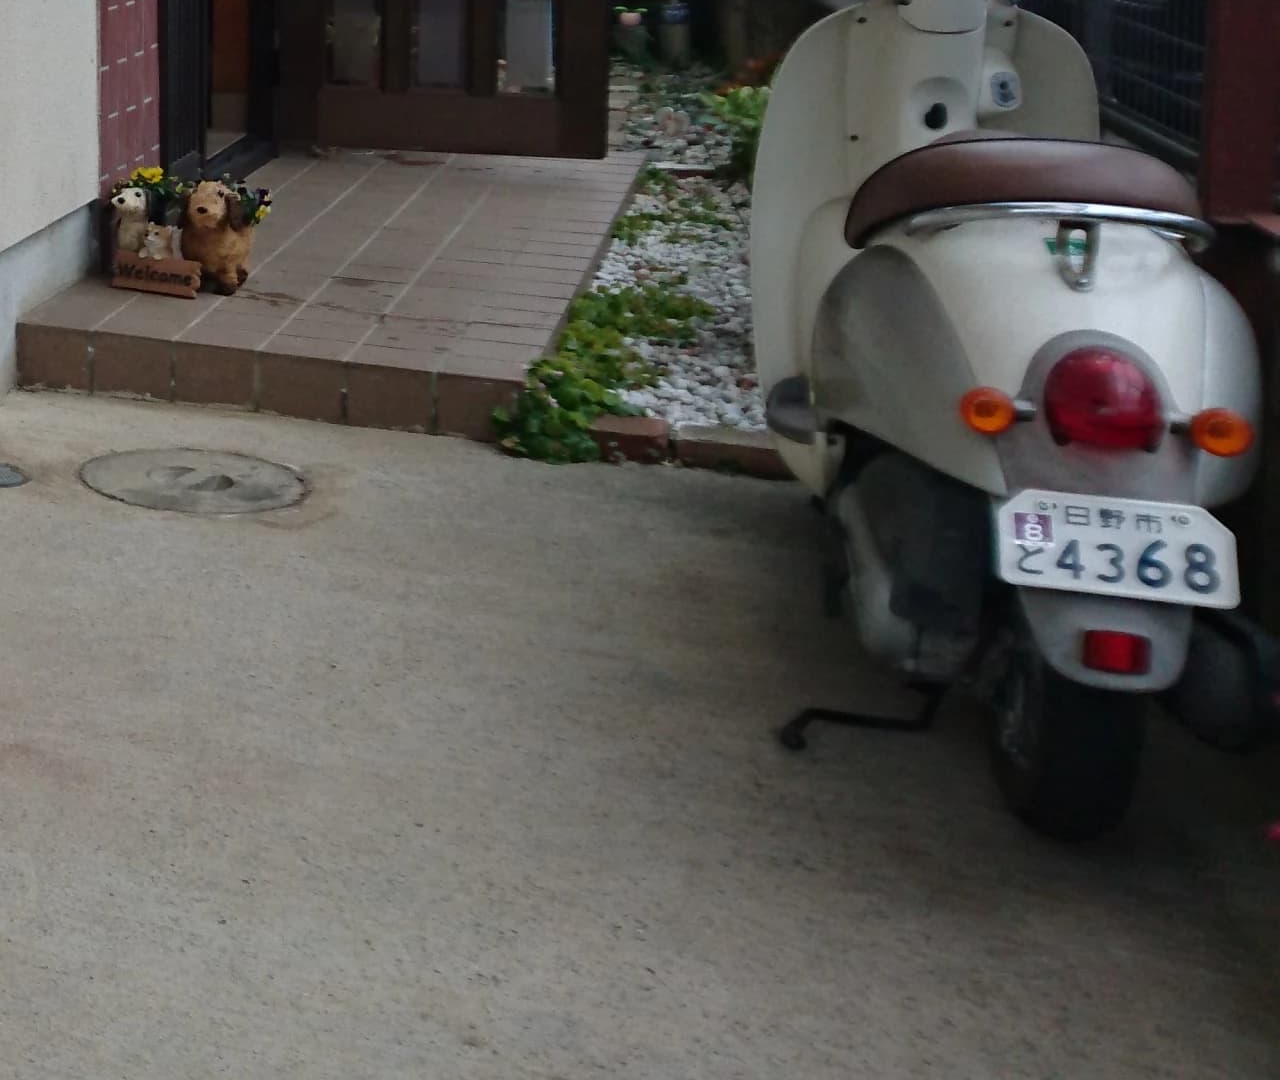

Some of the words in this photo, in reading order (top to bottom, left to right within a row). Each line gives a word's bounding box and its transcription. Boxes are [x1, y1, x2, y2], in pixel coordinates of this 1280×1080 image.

[117, 263, 195, 288] Welcome
[1064, 505, 1163, 534] 日野市
